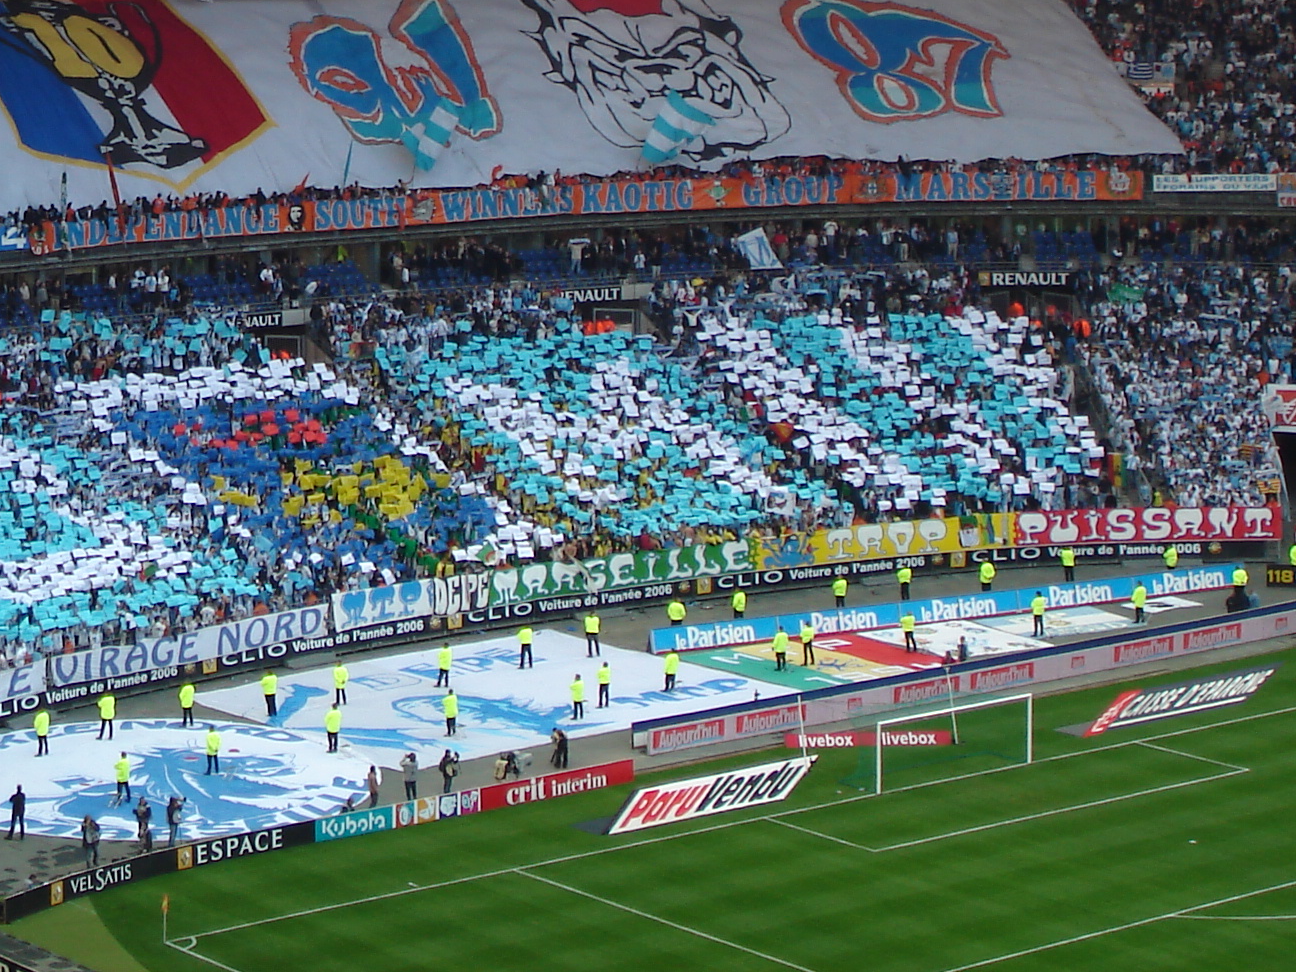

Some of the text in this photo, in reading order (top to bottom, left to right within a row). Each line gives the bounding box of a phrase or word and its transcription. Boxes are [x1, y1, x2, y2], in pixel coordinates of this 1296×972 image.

[10, 12, 145, 79] 10
[1187, 175, 1270, 183] UPPORTERS
[315, 196, 405, 231] SOUTH
[581, 179, 694, 213] KAOTIC
[742, 174, 845, 207] GROUP
[894, 170, 1097, 202] MARSILLE
[992, 272, 1070, 286] RENAULT
[827, 518, 947, 559] TROP
[1018, 507, 1275, 544] PUISSANT
[971, 543, 1202, 563] CLIO Voure de l'année 006
[493, 538, 754, 606] MARSEILLE
[717, 570, 784, 589] CLIO
[789, 566, 832, 580] Voiture
[834, 563, 849, 576] de
[852, 559, 893, 574] l'année
[1153, 569, 1225, 595] le Parisien
[1268, 570, 1294, 583] 118
[467, 584, 673, 623] CLIO Voiture de l'année 2006
[921, 595, 997, 622] le Parisien
[1049, 583, 1111, 607] Parisien
[218, 608, 322, 652] NORD
[812, 609, 878, 634] Parisien
[221, 619, 425, 667] CLIO Voiture de l'année 2006
[675, 624, 754, 651] le Parisien
[46, 685, 88, 704] Voiture
[90, 680, 104, 694] de
[108, 673, 148, 691] l'année
[151, 666, 178, 683] 2006
[1118, 685, 1182, 720] CAISSE
[658, 723, 721, 748] Aujourd'hui
[798, 733, 854, 748] livebox
[882, 730, 936, 746] livebox
[506, 777, 546, 805] crit
[618, 760, 807, 829] ParuVendu
[322, 814, 386, 838] Kubota
[196, 829, 284, 865] ESPACE
